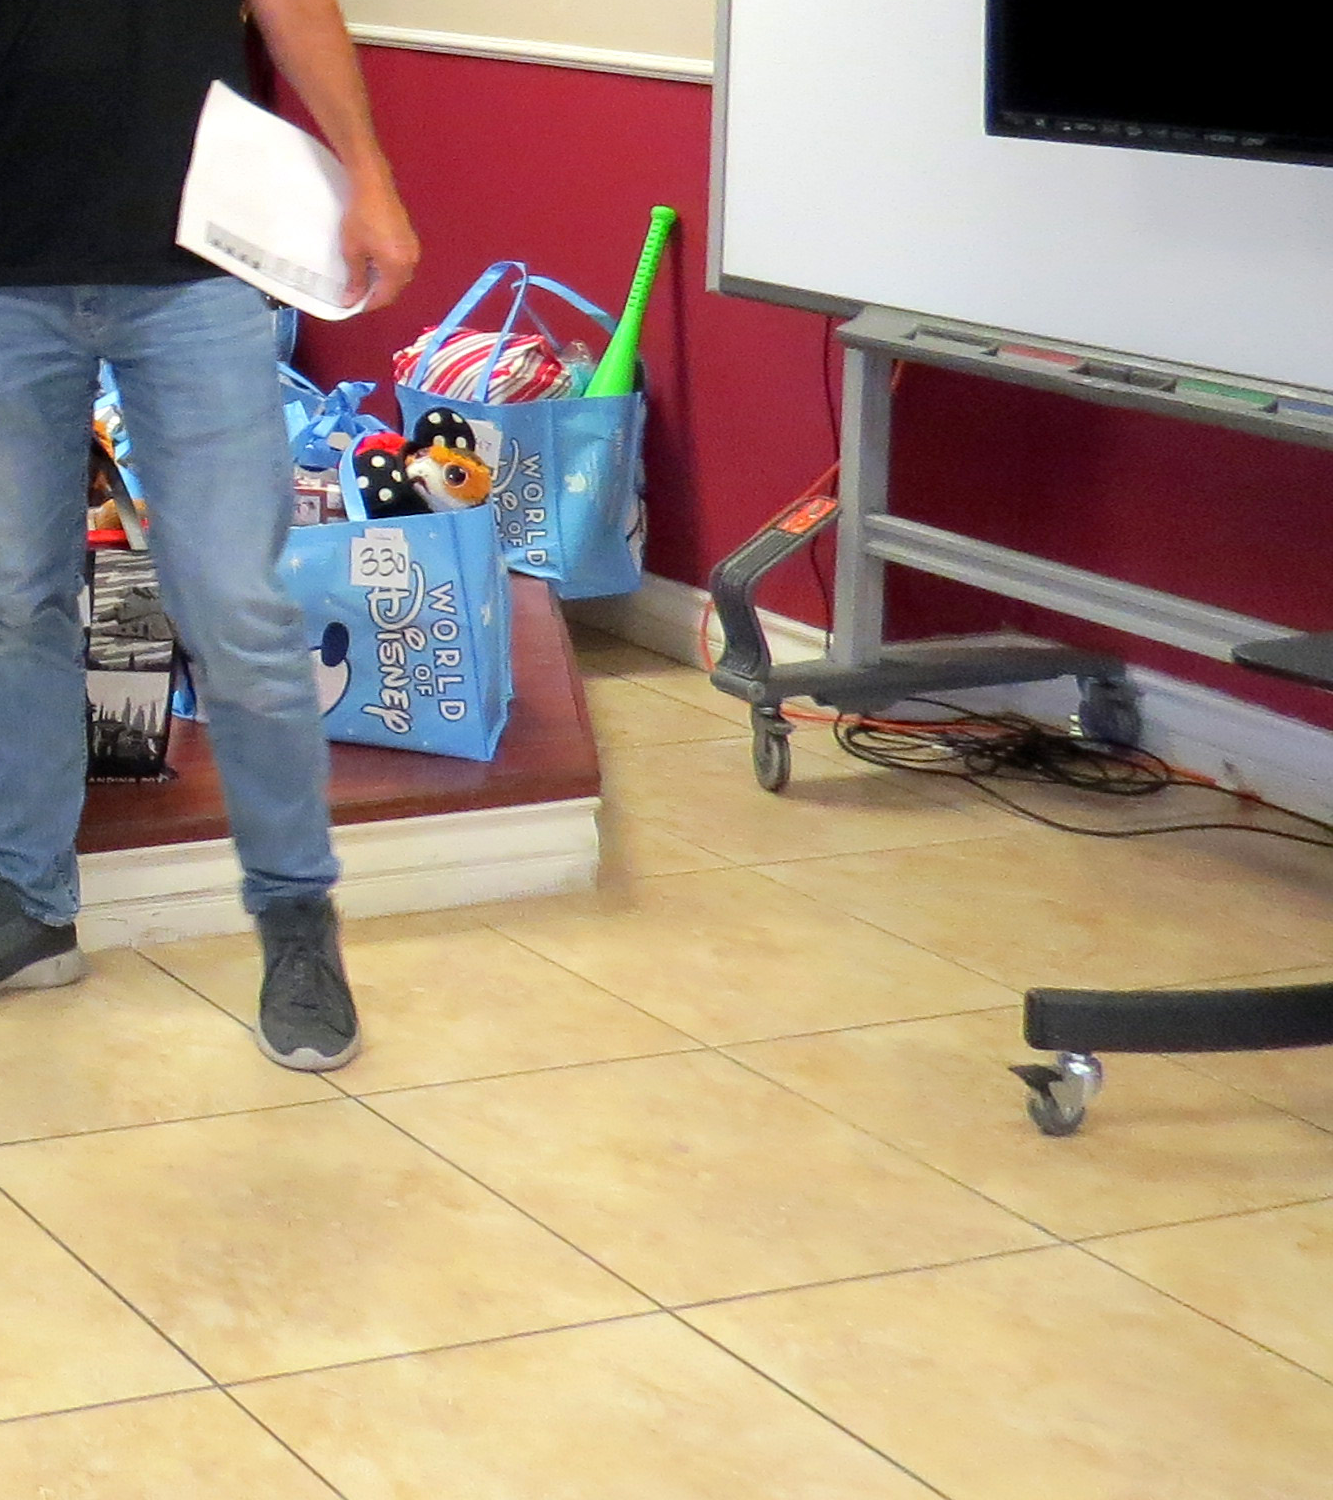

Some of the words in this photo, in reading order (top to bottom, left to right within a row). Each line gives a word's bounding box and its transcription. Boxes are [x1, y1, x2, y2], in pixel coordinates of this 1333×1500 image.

[507, 521, 523, 548] OF
[522, 451, 547, 566] WORLD
[414, 664, 433, 697] OF
[427, 580, 467, 722] WORLD
